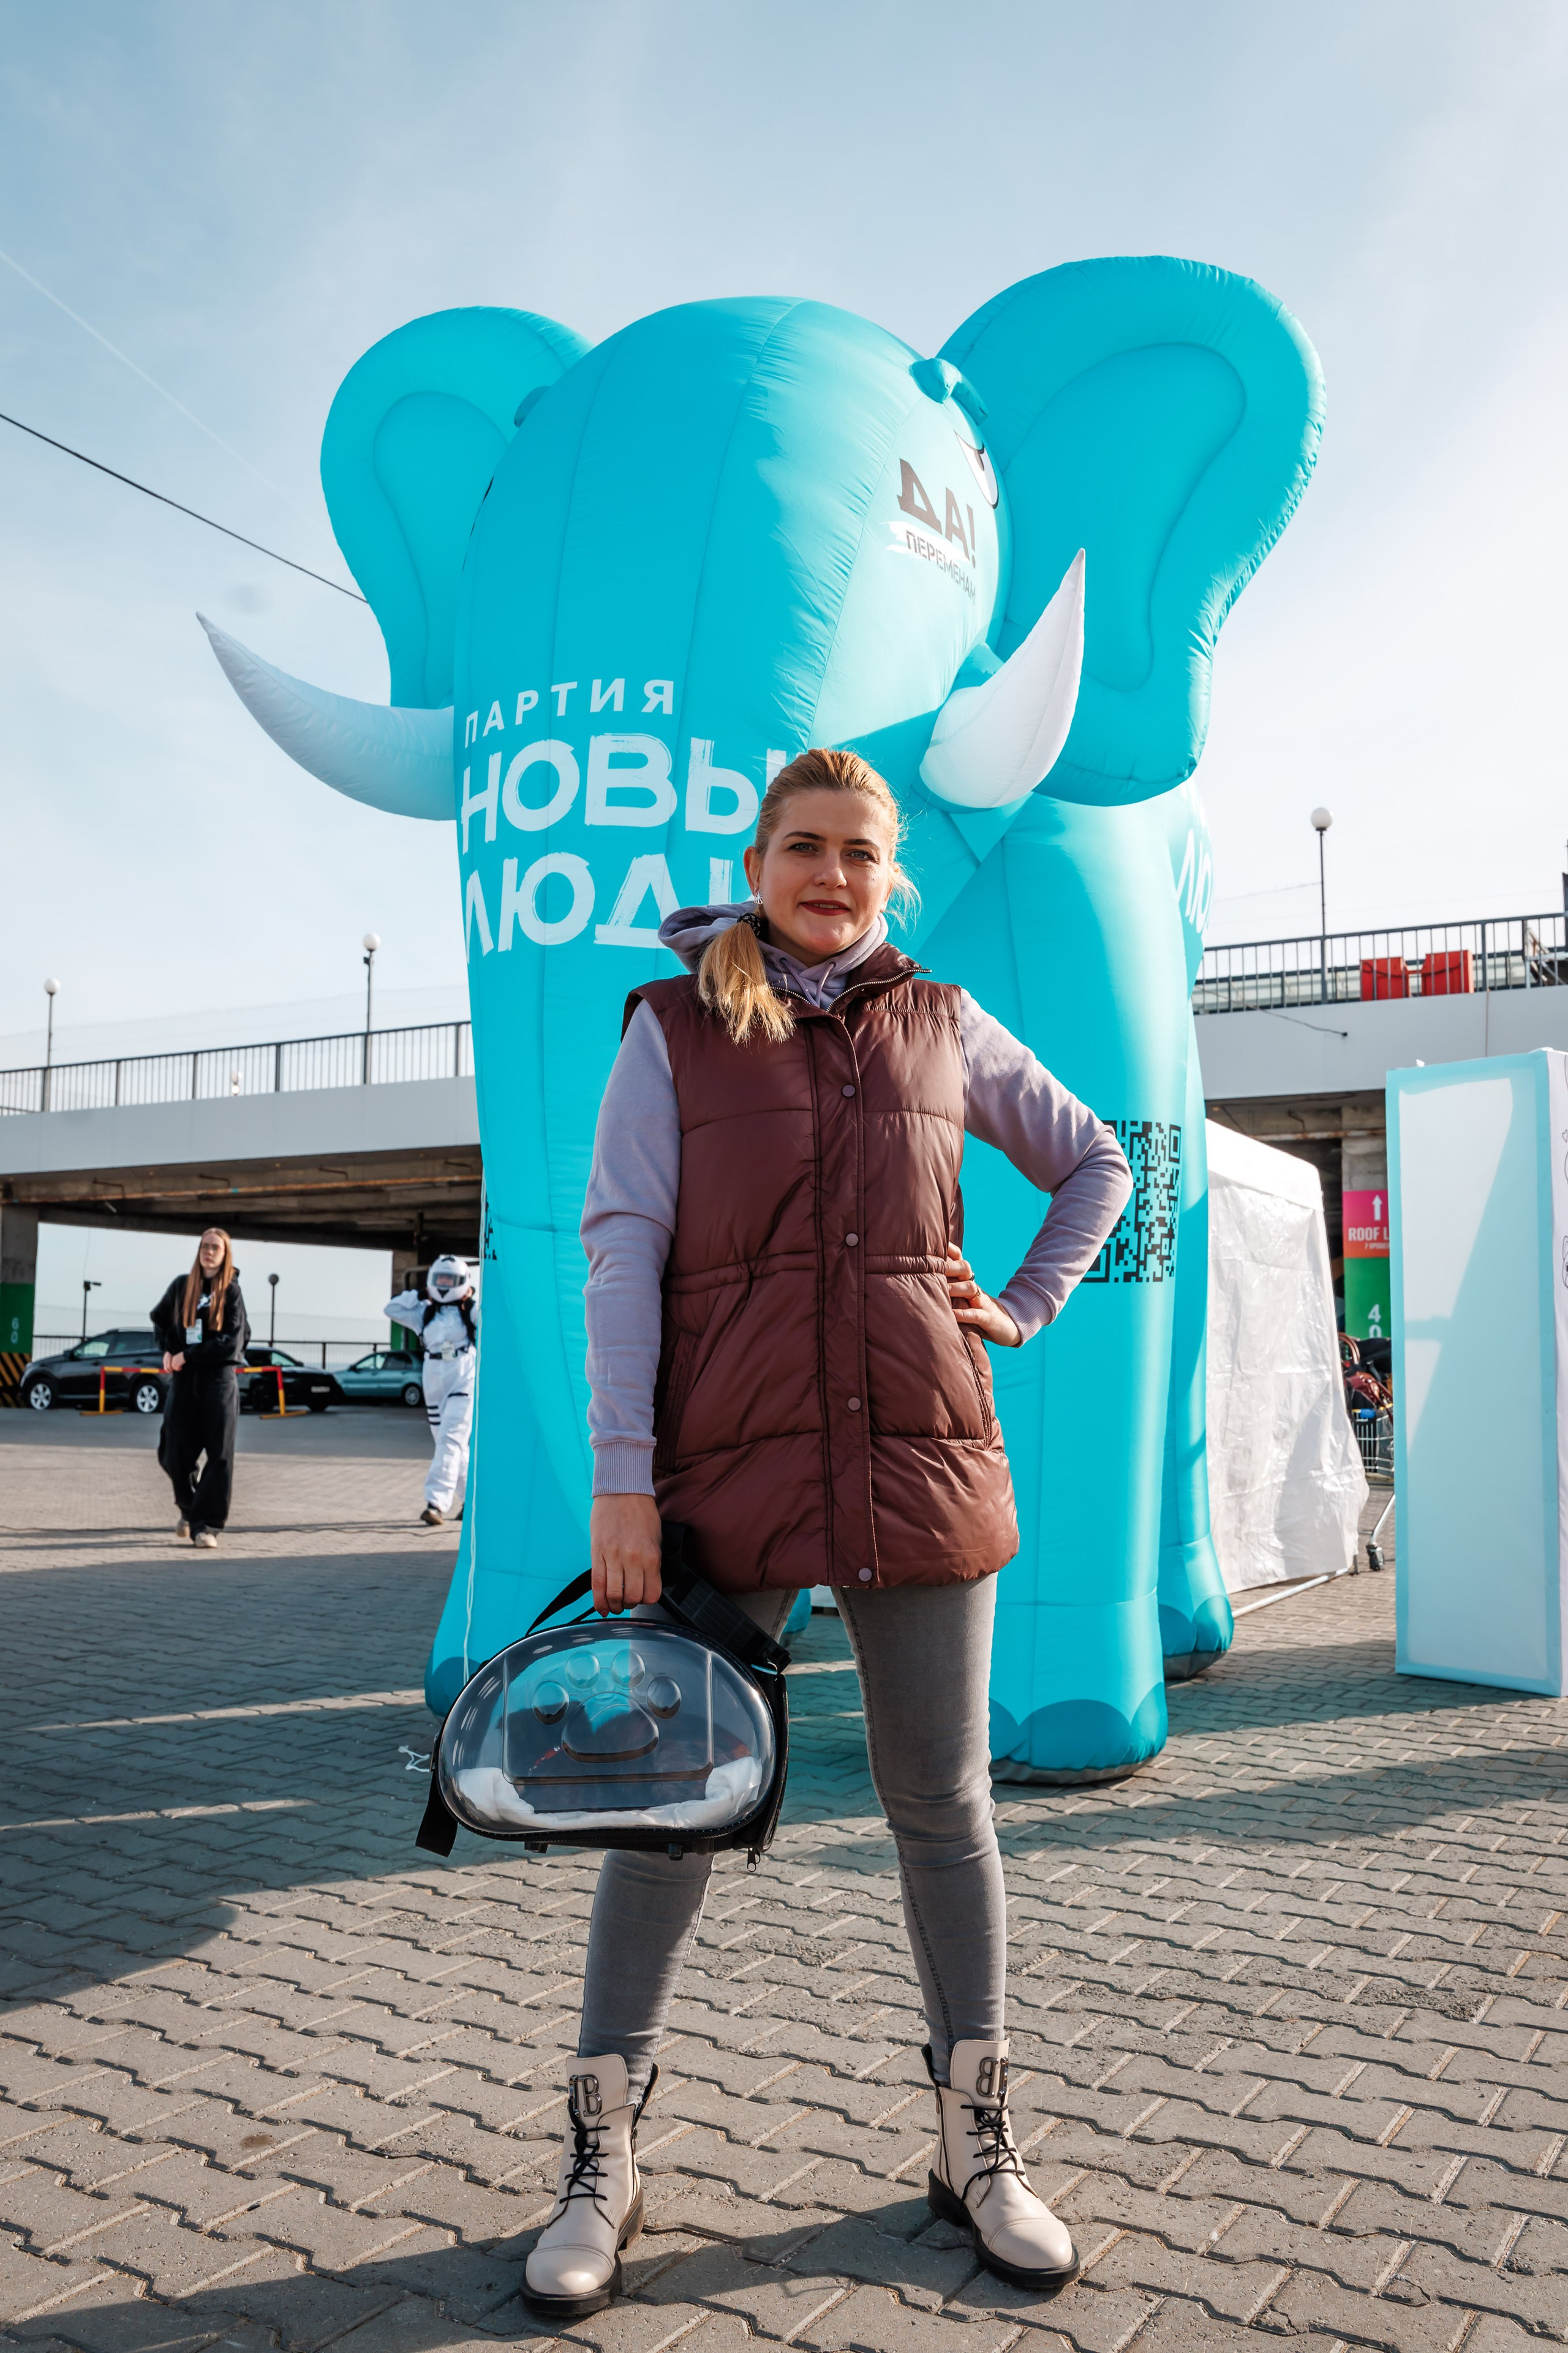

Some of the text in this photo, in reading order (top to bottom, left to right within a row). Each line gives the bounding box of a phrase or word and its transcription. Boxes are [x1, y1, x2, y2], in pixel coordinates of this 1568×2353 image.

[897, 458, 976, 569] ДА!
[905, 529, 976, 605] ПЕРЕМЕНАМ
[464, 678, 674, 749] ПАРТИЯ
[461, 733, 806, 855] НОВЫ
[1348, 1227, 1380, 1242] ROOF
